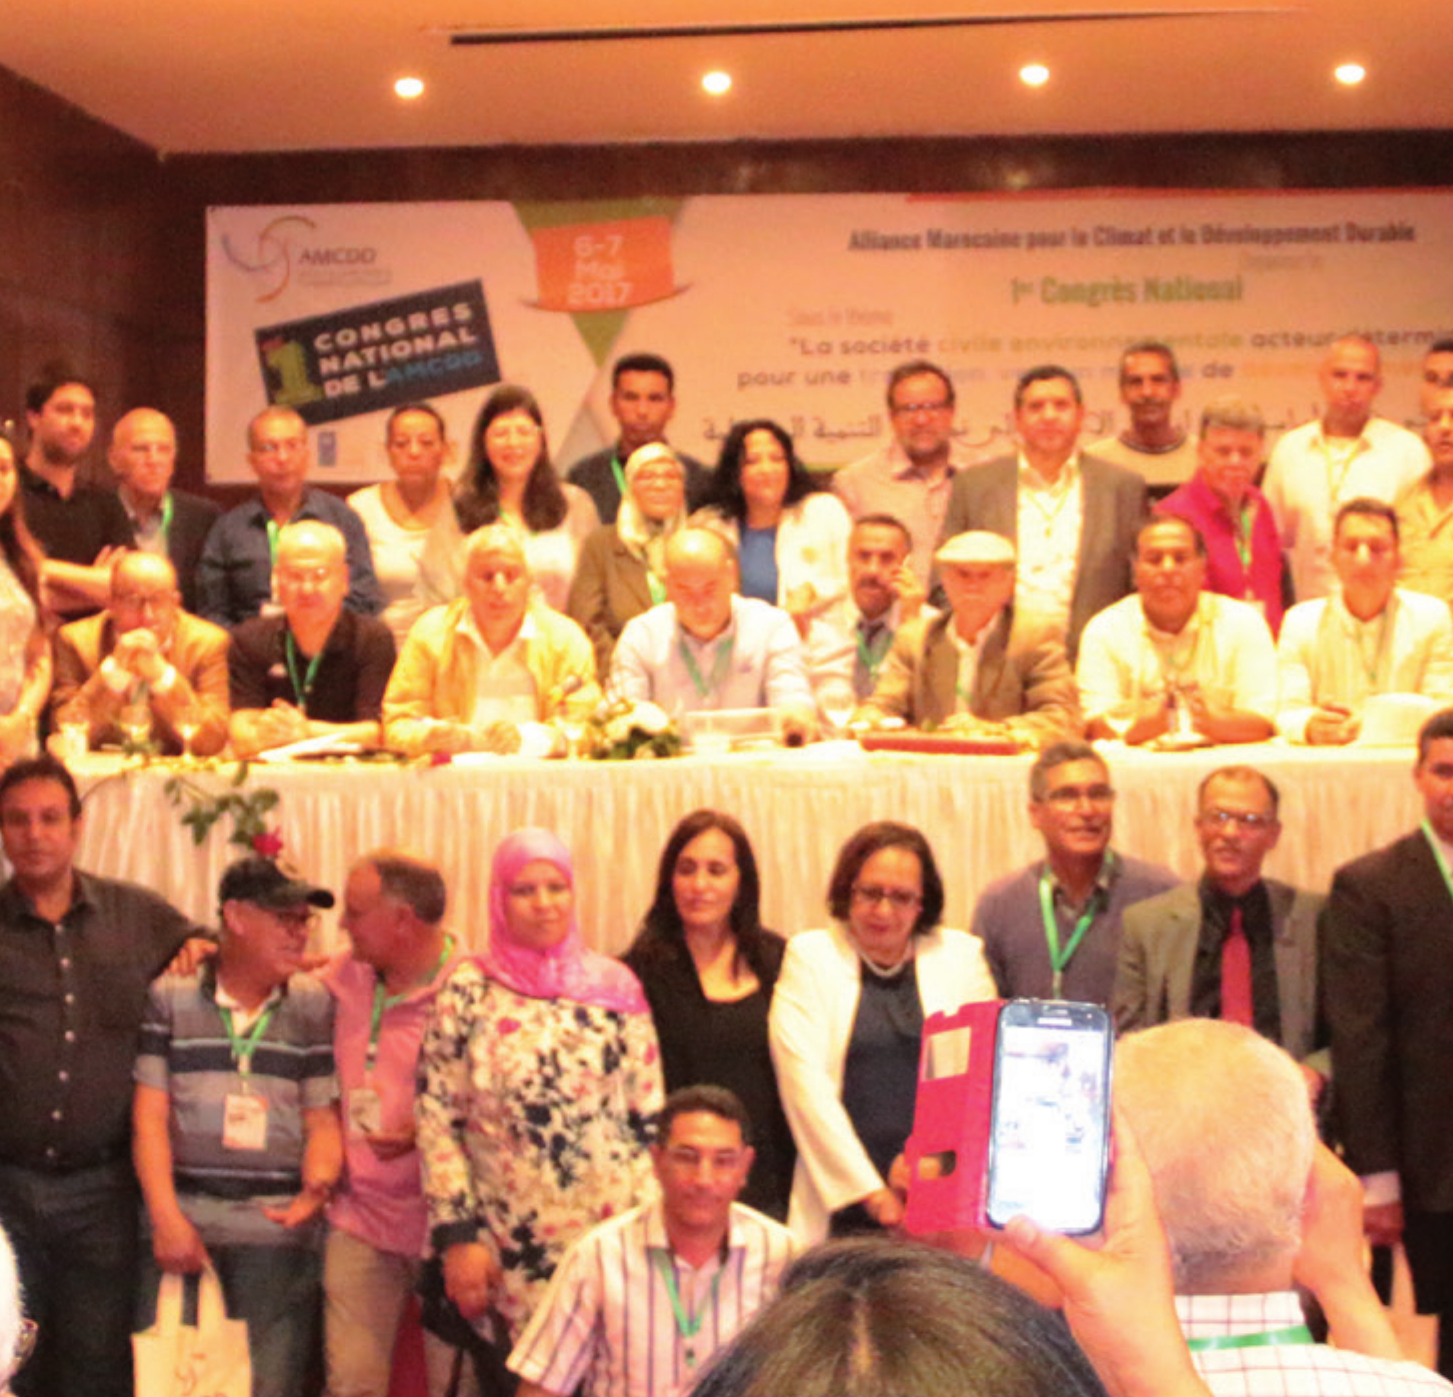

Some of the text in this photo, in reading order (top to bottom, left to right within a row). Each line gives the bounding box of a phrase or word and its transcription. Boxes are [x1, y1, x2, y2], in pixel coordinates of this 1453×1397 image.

[574, 235, 624, 257] 6-7
[1026, 231, 1065, 250] pour
[567, 281, 634, 305] 2017
[1142, 275, 1243, 302] National
[318, 326, 479, 375] NATIONAL
[323, 373, 362, 398] DE
[737, 369, 794, 392] pour
[804, 368, 851, 386] une
[1201, 360, 1235, 380] de
